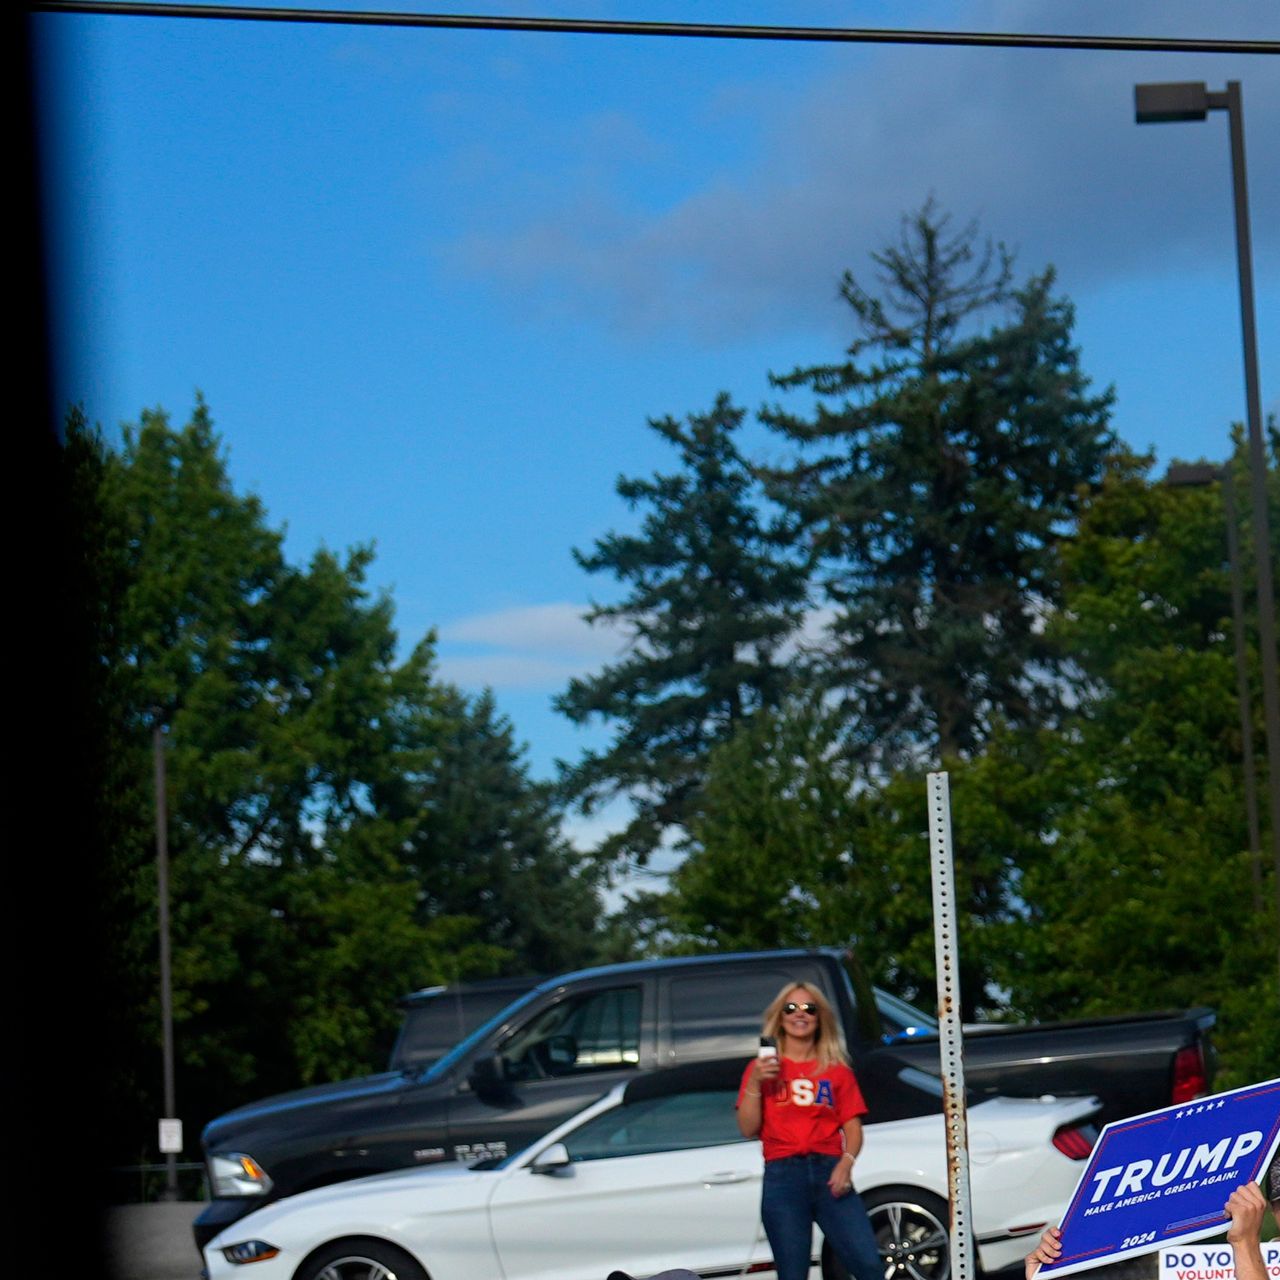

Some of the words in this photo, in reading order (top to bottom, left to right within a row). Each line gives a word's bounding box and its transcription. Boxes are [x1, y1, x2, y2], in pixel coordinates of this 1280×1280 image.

[1091, 1130, 1264, 1204] TRUMP
[1084, 1202, 1113, 1217] MAKE
[1115, 1190, 1162, 1209] AMERICA
[1164, 1180, 1199, 1196] GREAT
[1200, 1170, 1239, 1187] AGAIN!
[1120, 1230, 1156, 1249] 2024
[1165, 1252, 1197, 1269] DO
[1203, 1251, 1231, 1267] YO
[1176, 1268, 1236, 1280] VOLUNT
